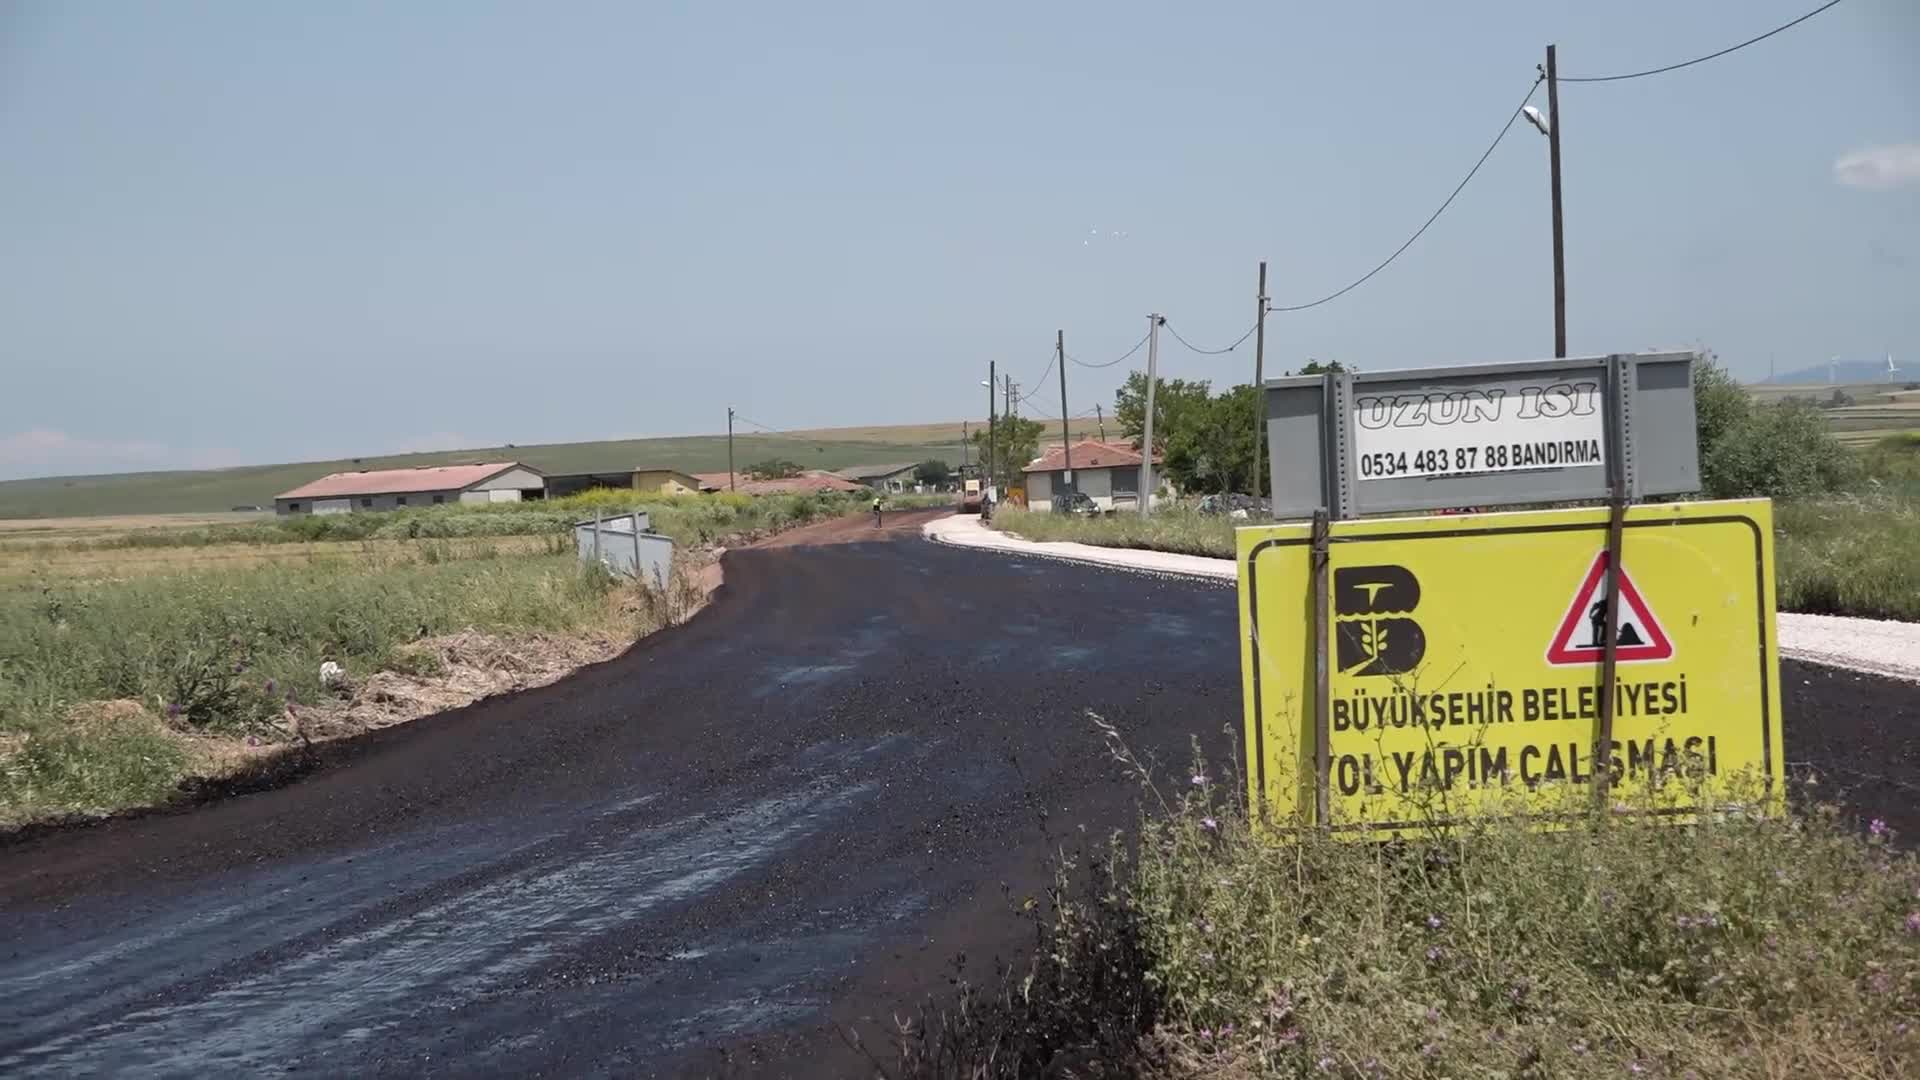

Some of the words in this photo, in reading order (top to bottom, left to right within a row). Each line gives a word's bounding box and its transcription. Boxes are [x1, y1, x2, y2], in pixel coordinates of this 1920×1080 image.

[1357, 389, 1506, 430] UZUN
[1517, 382, 1597, 419] ISI
[1360, 451, 1408, 477] 0534
[1414, 448, 1449, 473] 483
[1455, 447, 1478, 470] 87
[1485, 445, 1508, 468] 88
[1512, 439, 1601, 466] BANDIRMA
[1333, 683, 1514, 732] BÜYÜKŞEHİR
[1392, 746, 1508, 794] YAPIM
[1520, 735, 1718, 793] ÇALŞMASI
